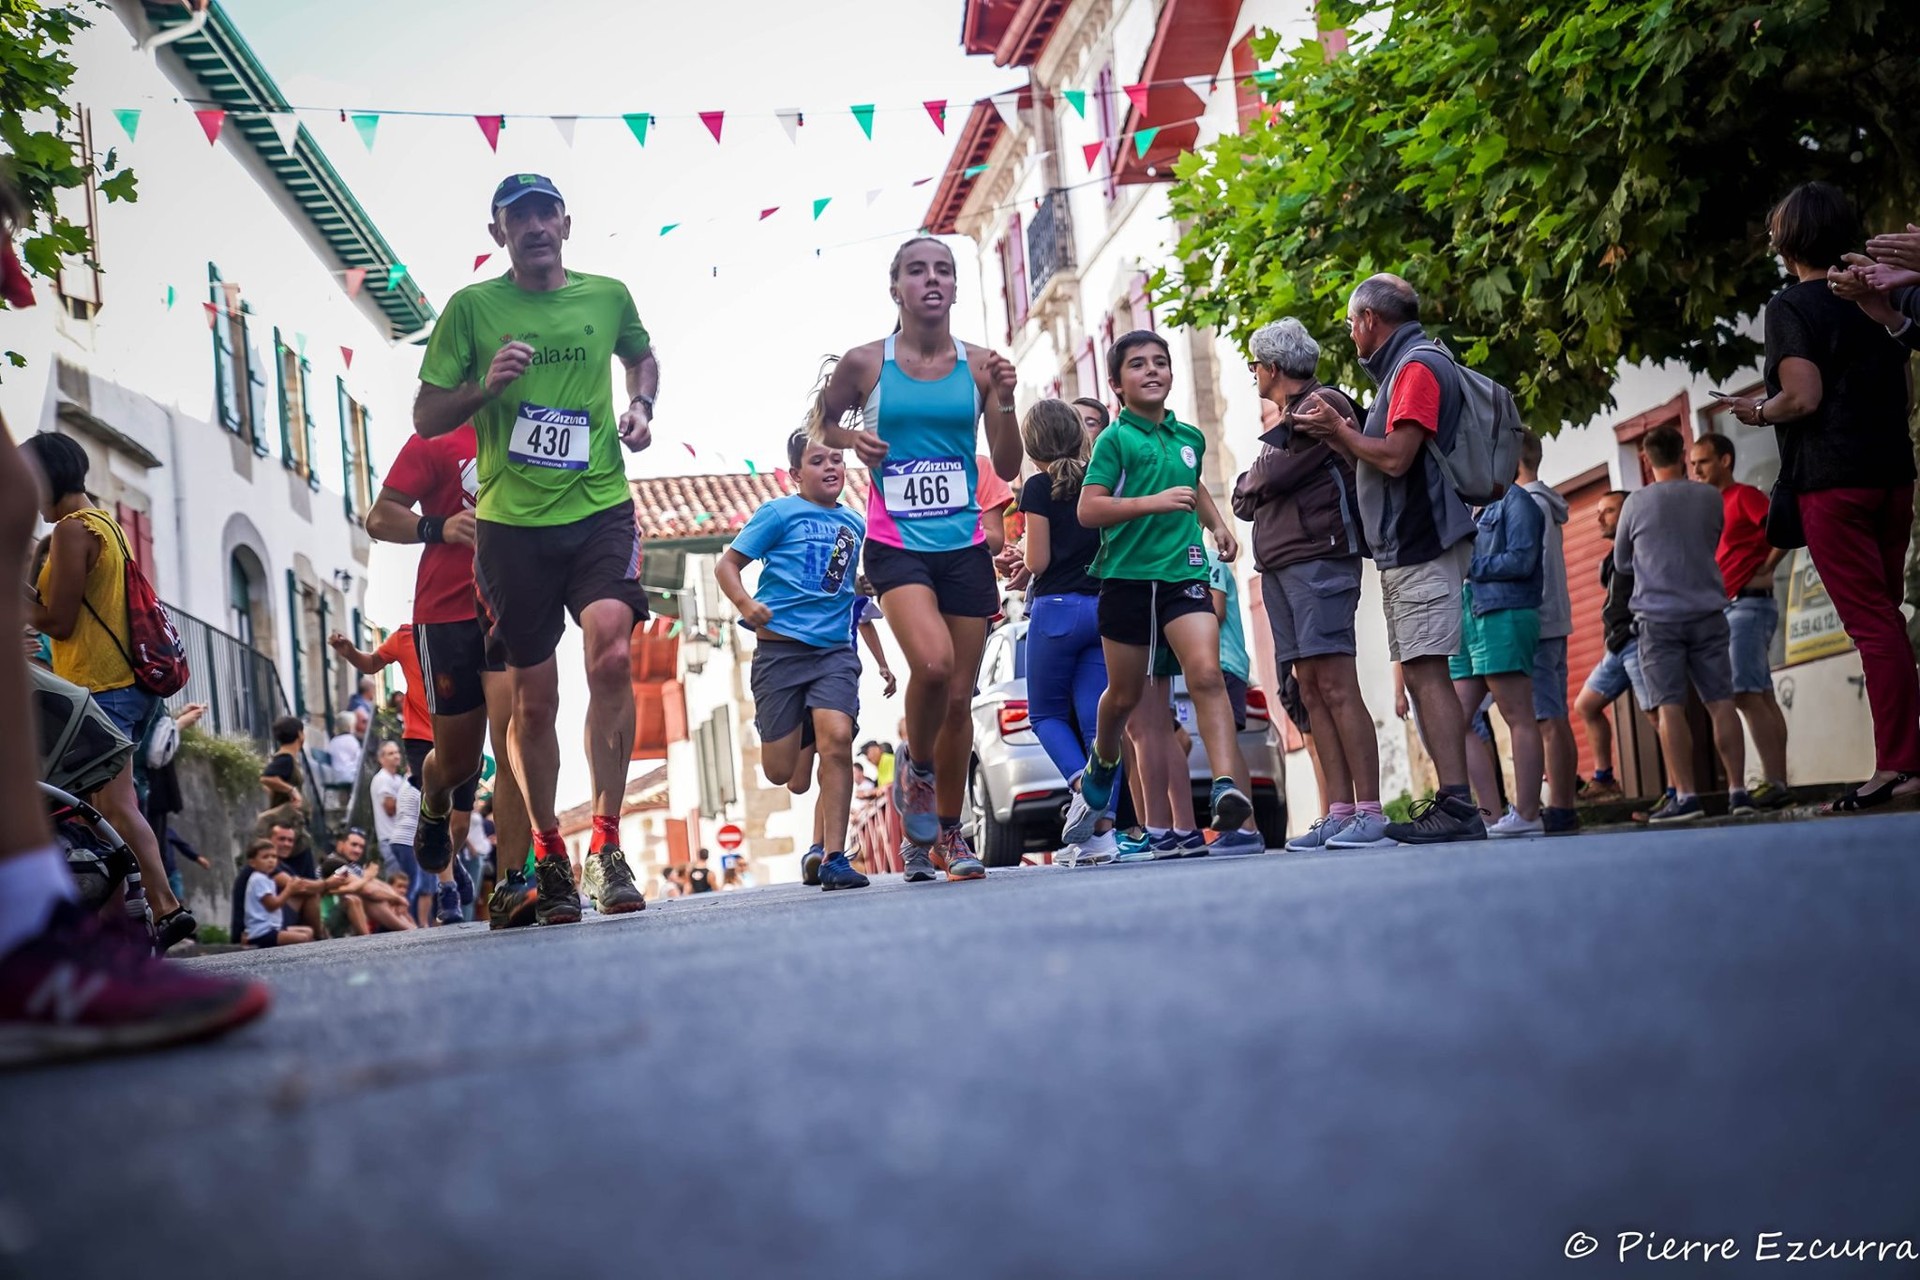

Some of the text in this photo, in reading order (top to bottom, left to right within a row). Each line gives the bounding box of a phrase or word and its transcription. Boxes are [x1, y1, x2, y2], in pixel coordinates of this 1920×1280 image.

[527, 424, 571, 458] 430
[527, 458, 568, 468] www.mizuno.fr
[903, 475, 950, 507] 466
[908, 509, 949, 518] www.mizuno.fr
